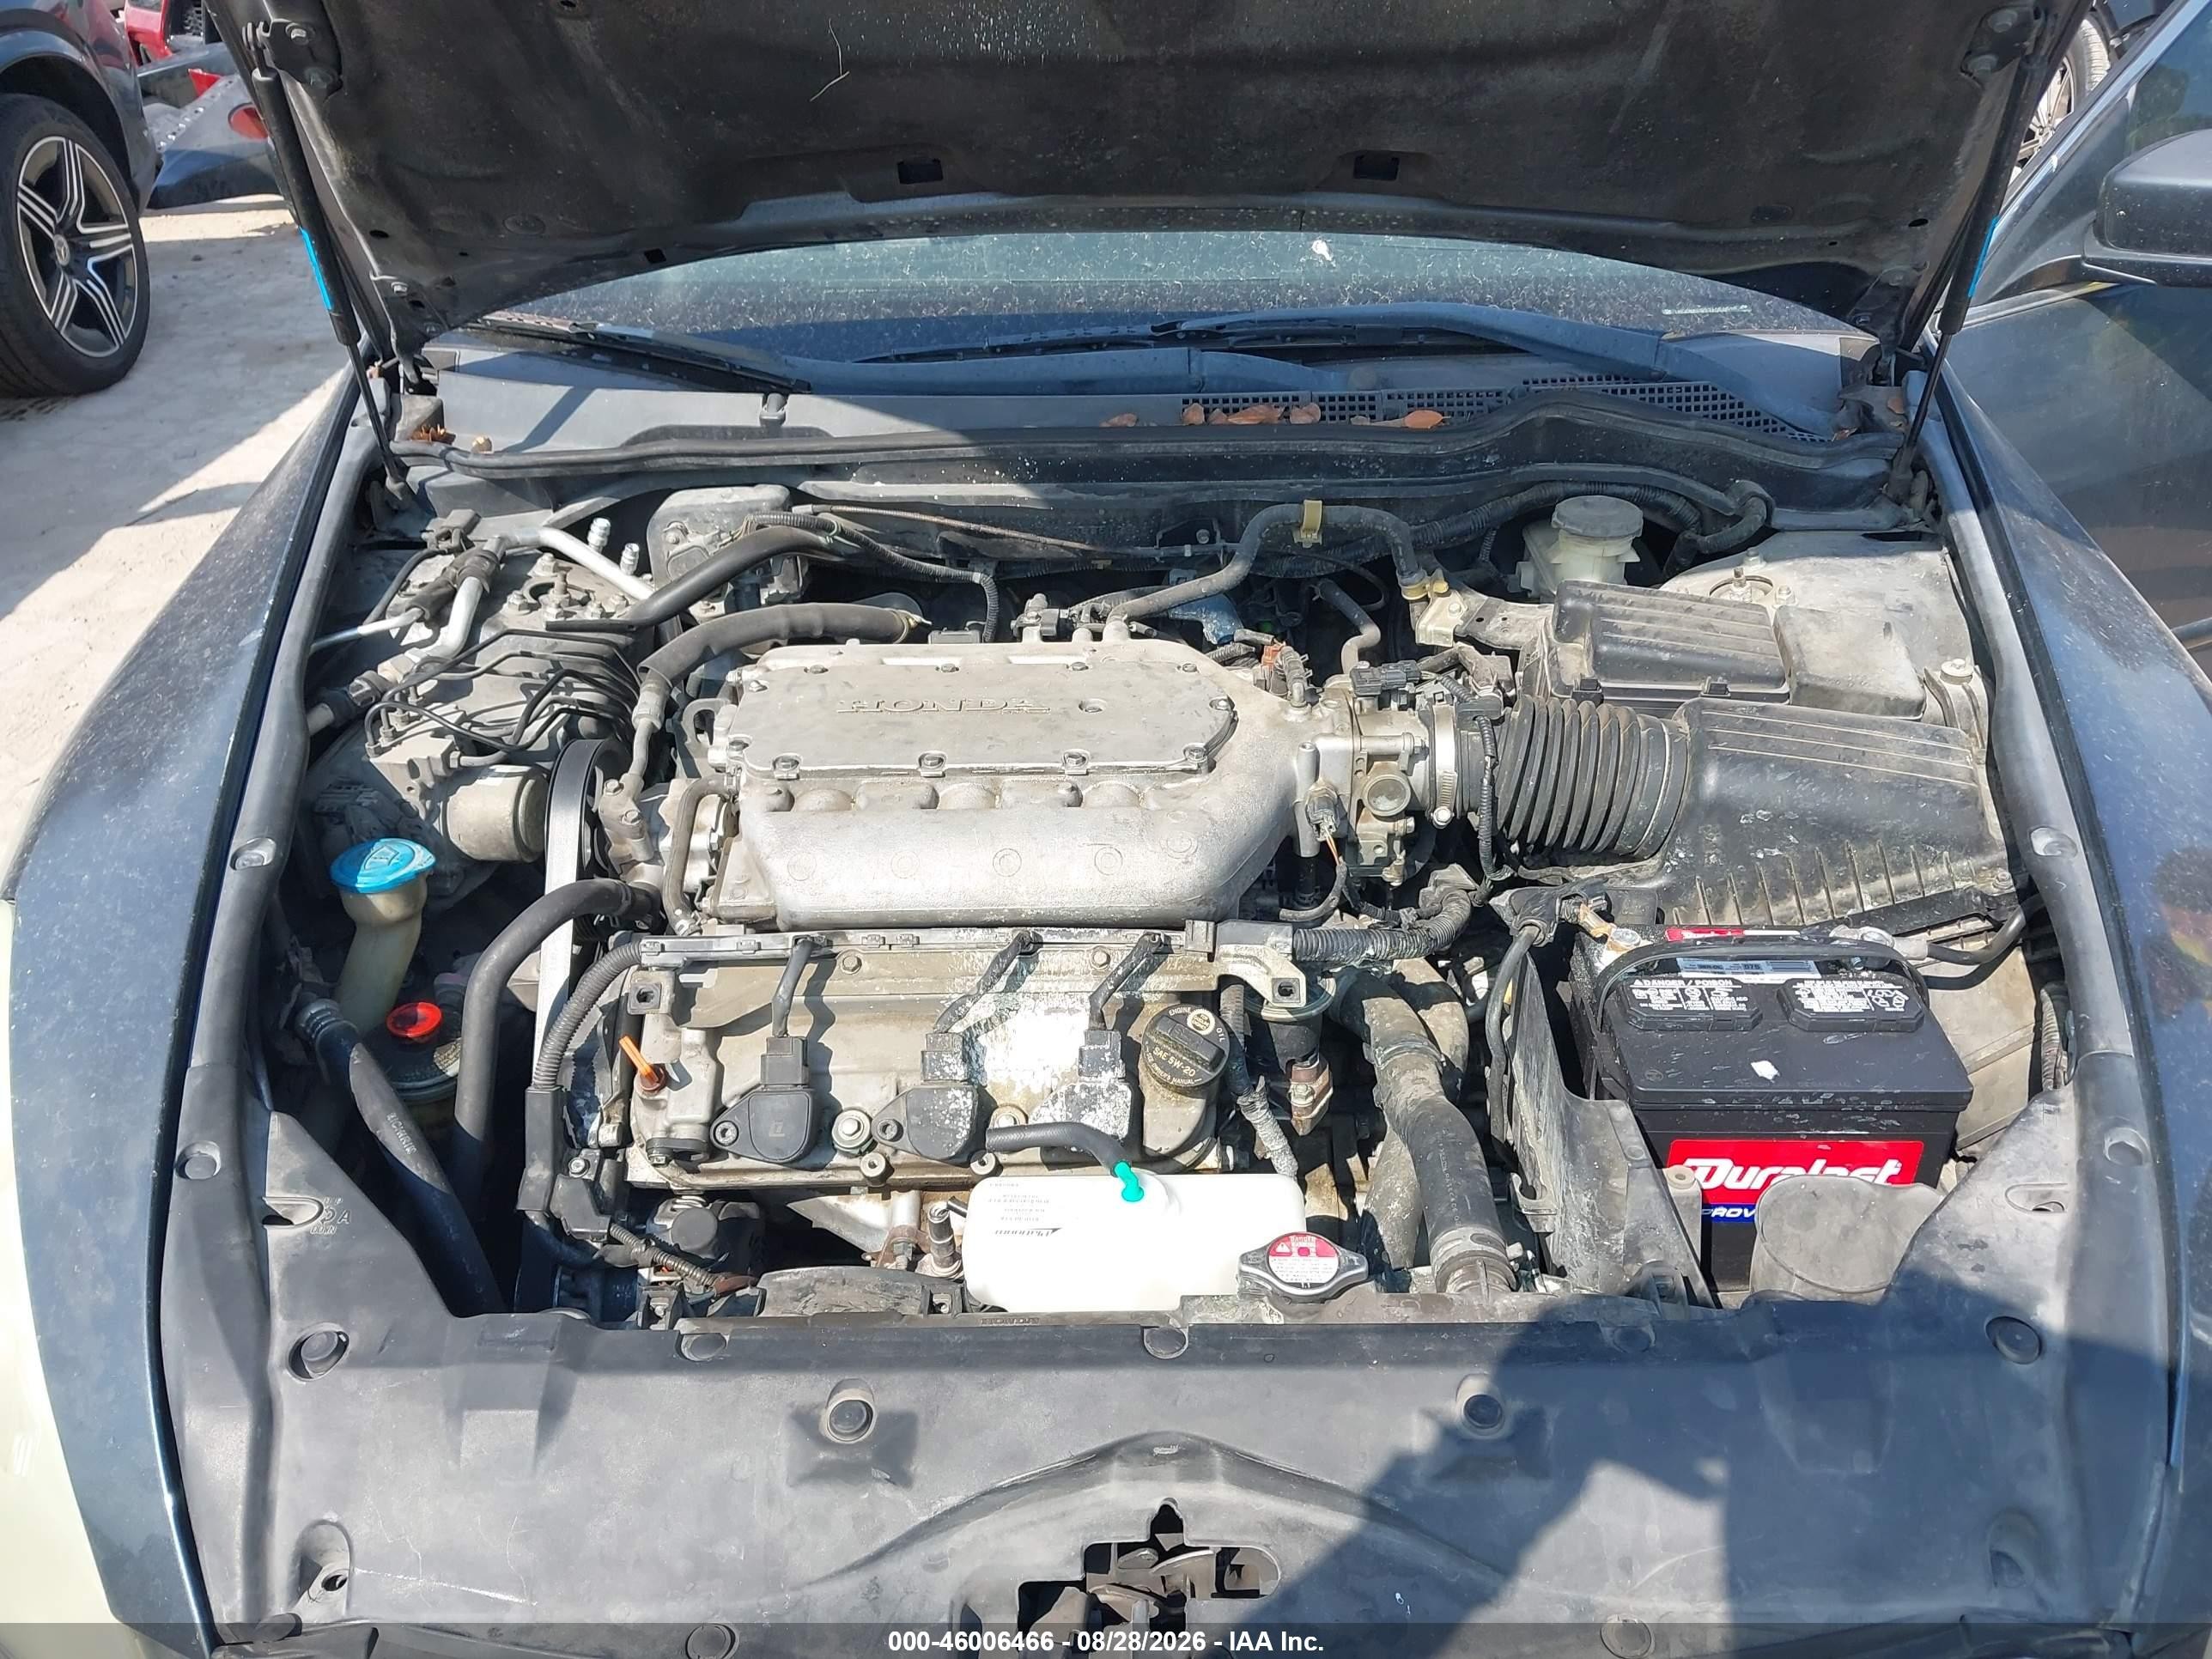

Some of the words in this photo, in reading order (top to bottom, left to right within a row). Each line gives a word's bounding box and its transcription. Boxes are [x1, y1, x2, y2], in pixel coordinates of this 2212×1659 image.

[836, 698, 1050, 714] HONDA
[1168, 1006, 1192, 1017] ENGINE
[1216, 1027, 1226, 1042] OIL
[1152, 1047, 1169, 1060] SAE
[1168, 1056, 1196, 1078] 5W-20
